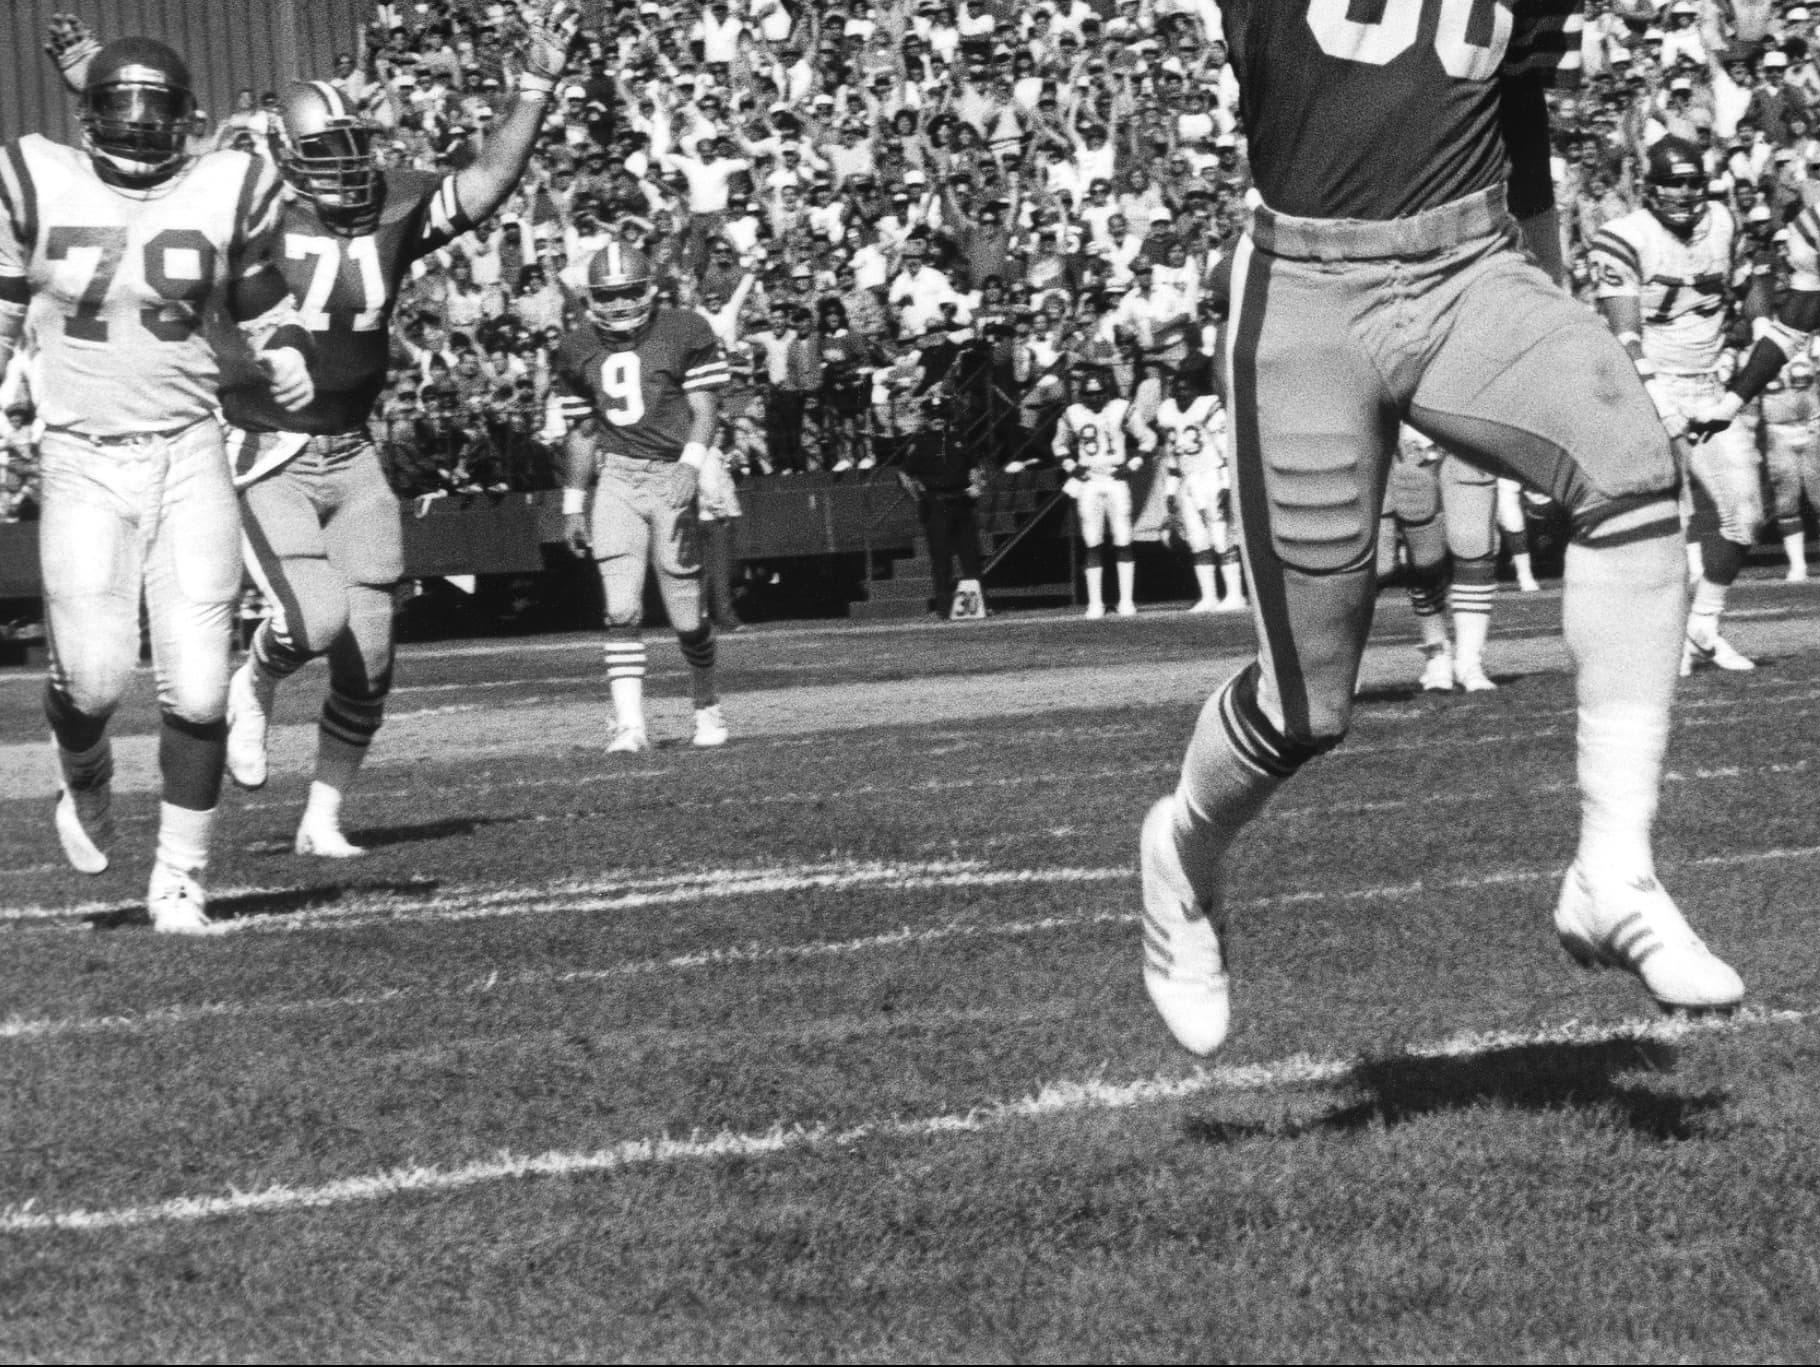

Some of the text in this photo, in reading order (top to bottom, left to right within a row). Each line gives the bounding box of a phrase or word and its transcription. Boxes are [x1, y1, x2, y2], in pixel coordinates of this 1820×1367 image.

[47, 226, 217, 343] 79
[285, 234, 386, 332] 71
[600, 351, 643, 427] 9
[1079, 423, 1116, 457] 81
